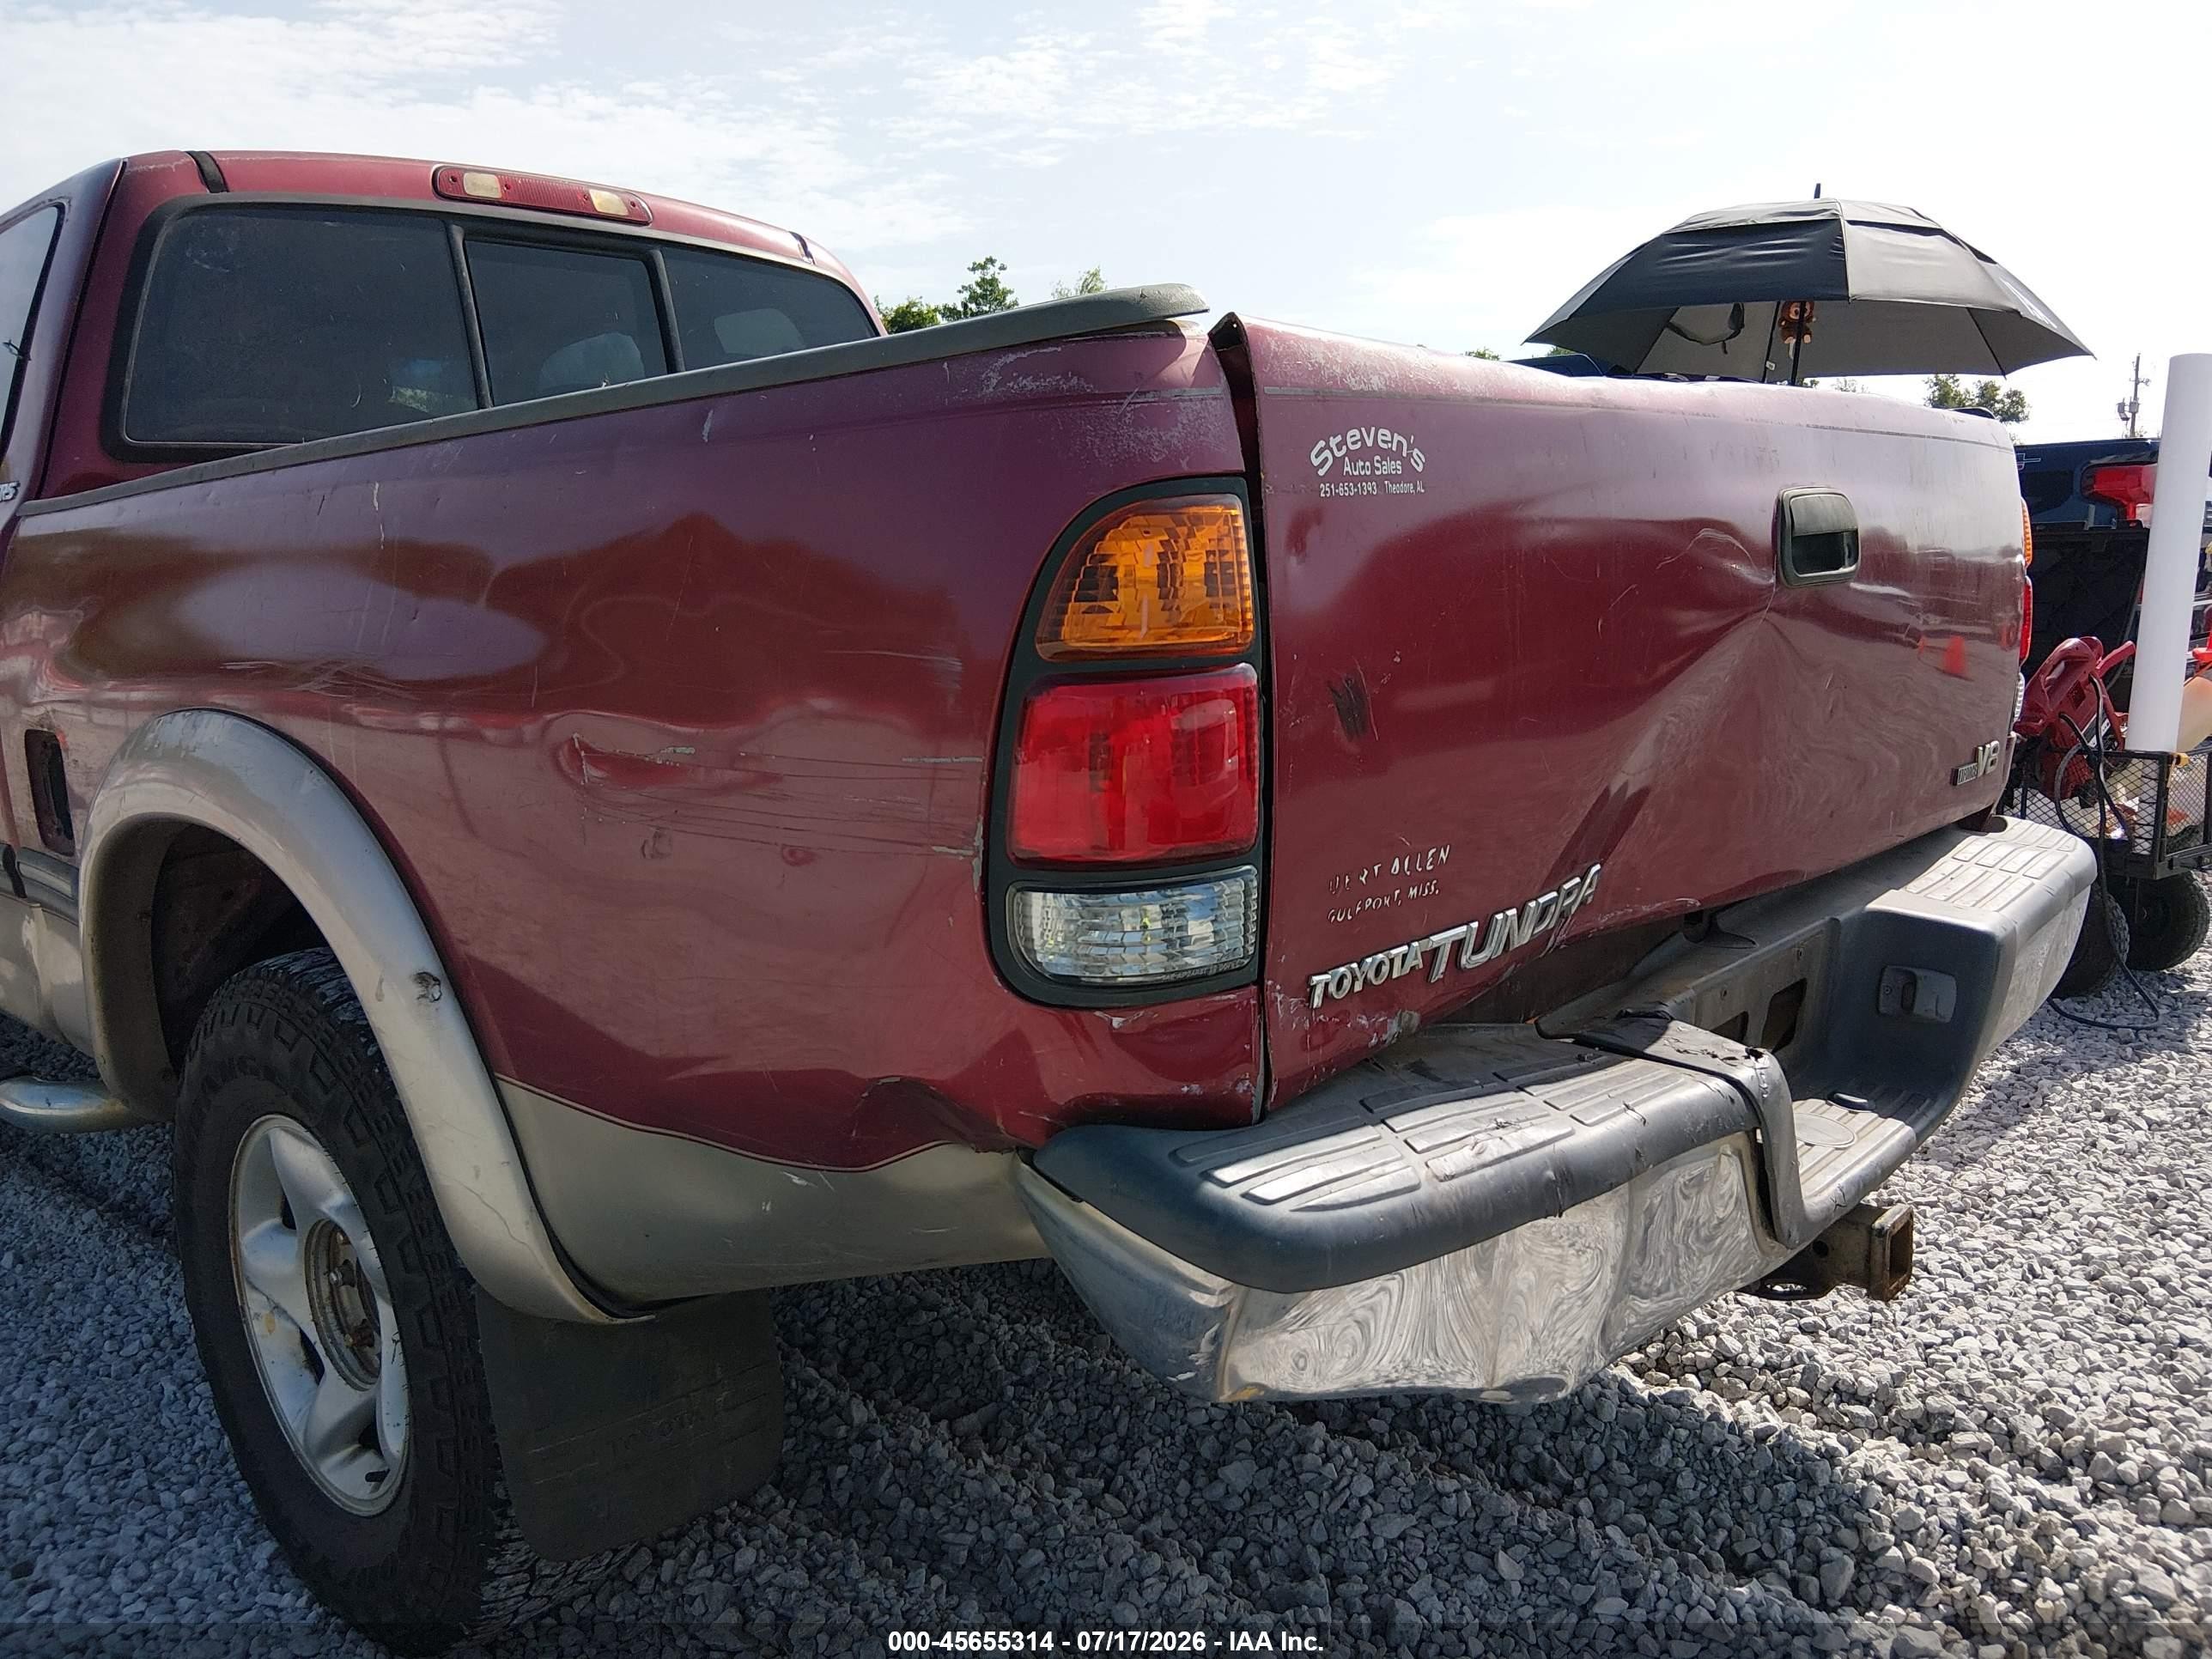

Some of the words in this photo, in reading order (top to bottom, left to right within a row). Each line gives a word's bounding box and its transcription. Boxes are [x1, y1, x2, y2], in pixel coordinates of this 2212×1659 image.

[1310, 426, 1426, 477] Steven's
[1343, 456, 1371, 476] Auto
[1374, 455, 1402, 475] Sales
[1320, 481, 1377, 497] 251-653-1393
[1384, 480, 1416, 495] Theodore,
[1417, 481, 1425, 493] AL
[1977, 740, 2000, 779] V8
[1389, 844, 1451, 876] ALLEN
[1407, 879, 1440, 900] MISS.
[1308, 941, 1423, 1010] TOYOTA
[1428, 863, 1602, 983] TUNDRA
